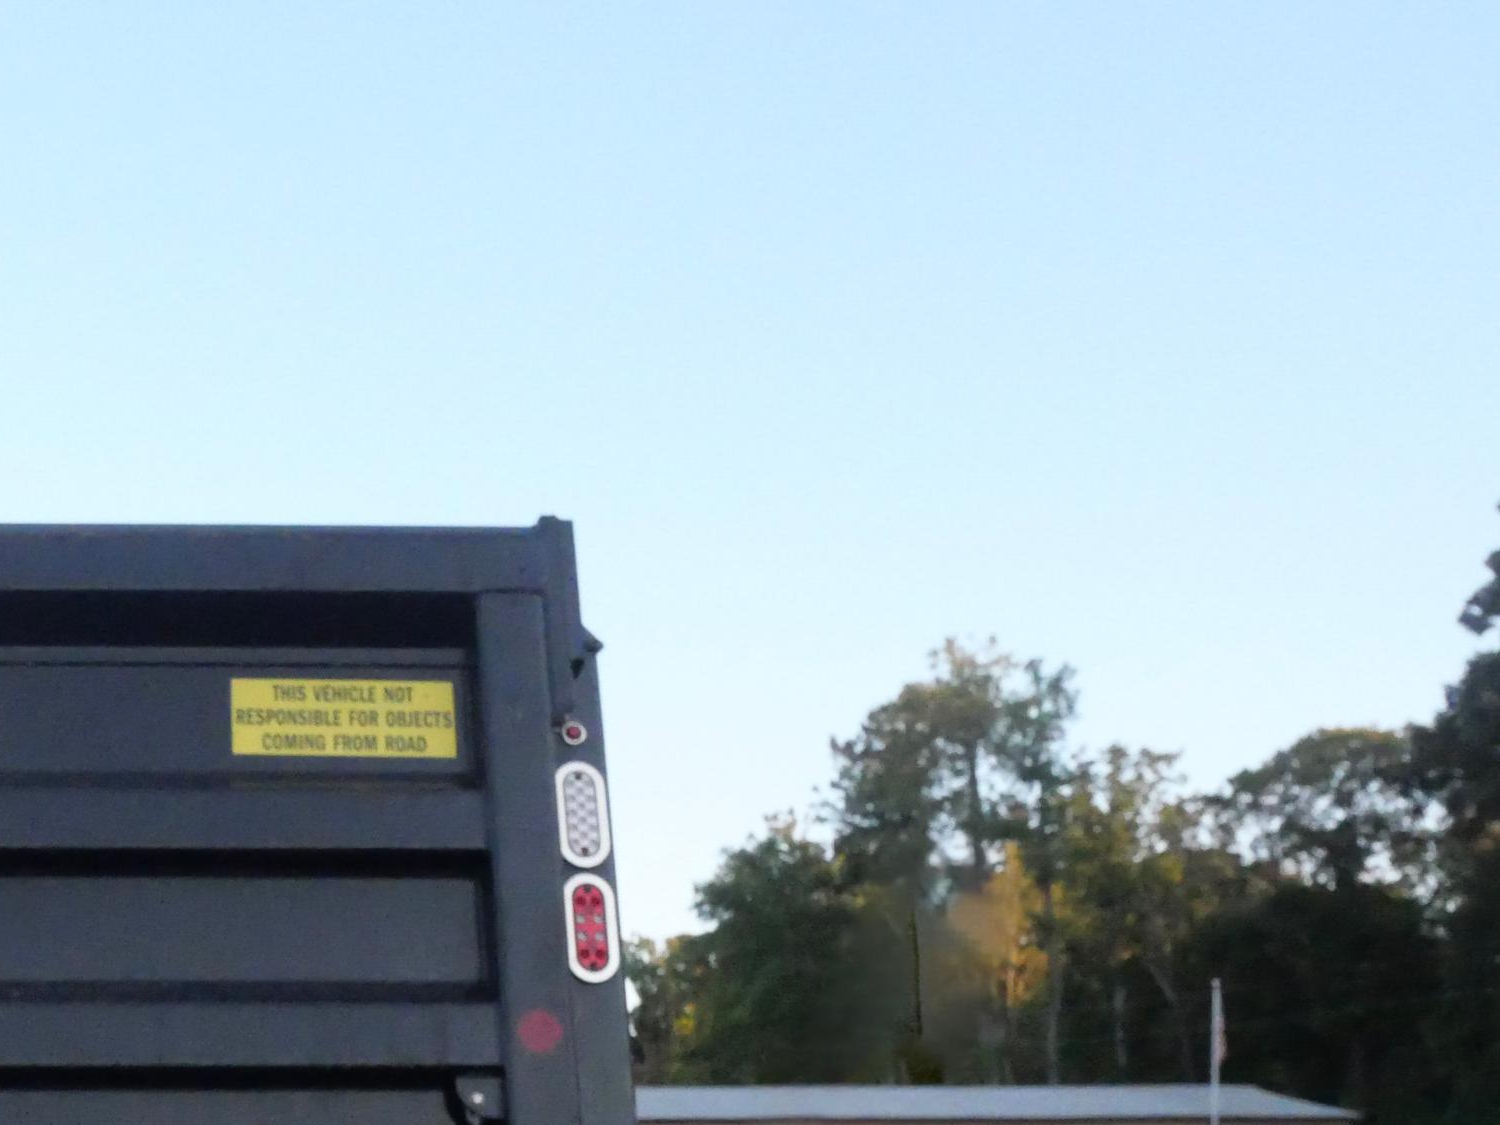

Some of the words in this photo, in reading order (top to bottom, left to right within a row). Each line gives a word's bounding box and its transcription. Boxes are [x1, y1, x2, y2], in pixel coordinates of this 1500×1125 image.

[273, 685, 306, 701] THIS
[313, 685, 376, 703] VEHICLE
[383, 686, 413, 702] NOT
[236, 708, 341, 726] RESPONSIBLE
[349, 709, 379, 727] FOR
[385, 711, 453, 729] OBJECTS
[262, 732, 326, 751] COMING
[333, 734, 378, 752] FROM
[385, 736, 427, 753] ROAD
